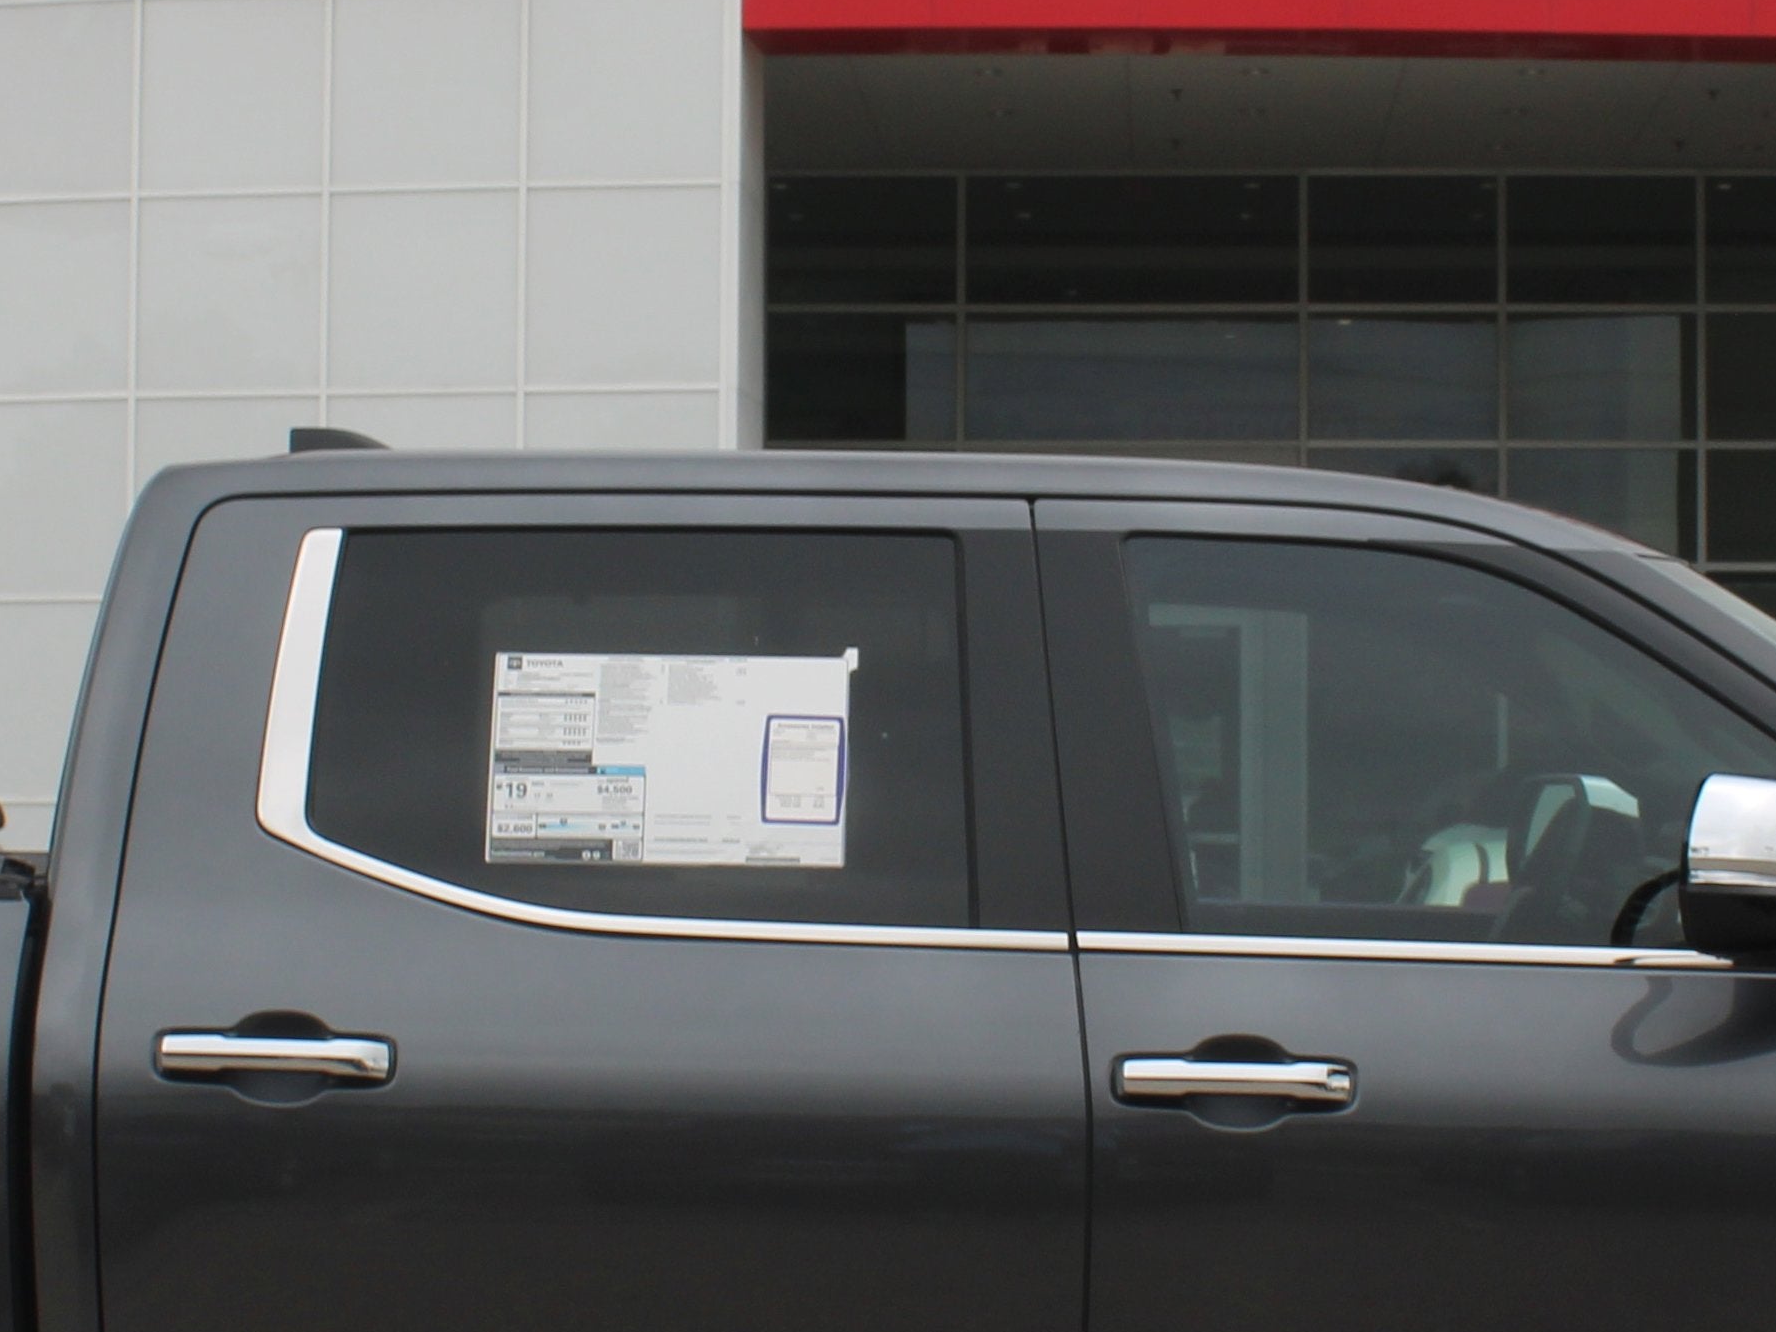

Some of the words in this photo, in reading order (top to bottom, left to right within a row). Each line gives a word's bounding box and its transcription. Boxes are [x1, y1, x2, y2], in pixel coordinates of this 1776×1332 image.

[526, 659, 564, 668] TOYOTA
[505, 781, 528, 799] 19
[596, 784, 634, 795] $4,500
